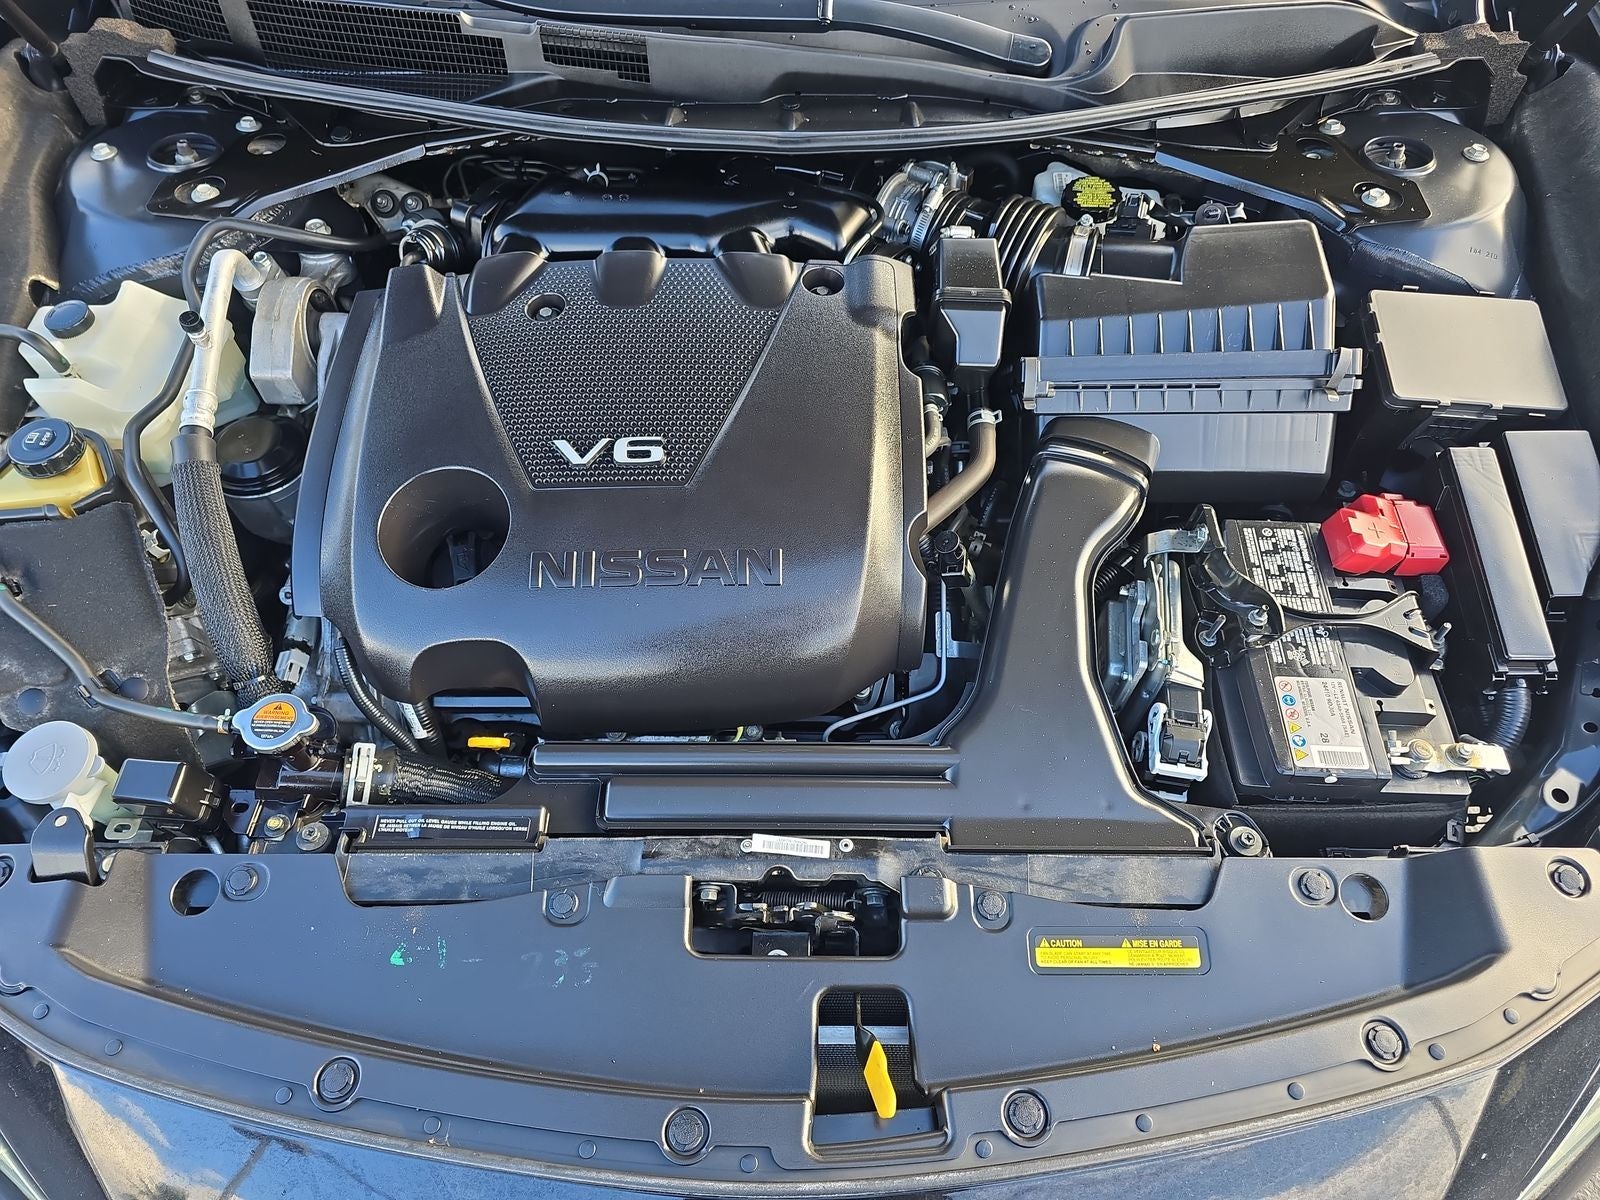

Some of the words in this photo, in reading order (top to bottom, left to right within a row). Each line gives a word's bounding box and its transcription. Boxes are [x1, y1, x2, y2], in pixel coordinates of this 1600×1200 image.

[552, 436, 666, 467] V6
[528, 548, 784, 589] NISSAN
[1319, 732, 1330, 743] 28
